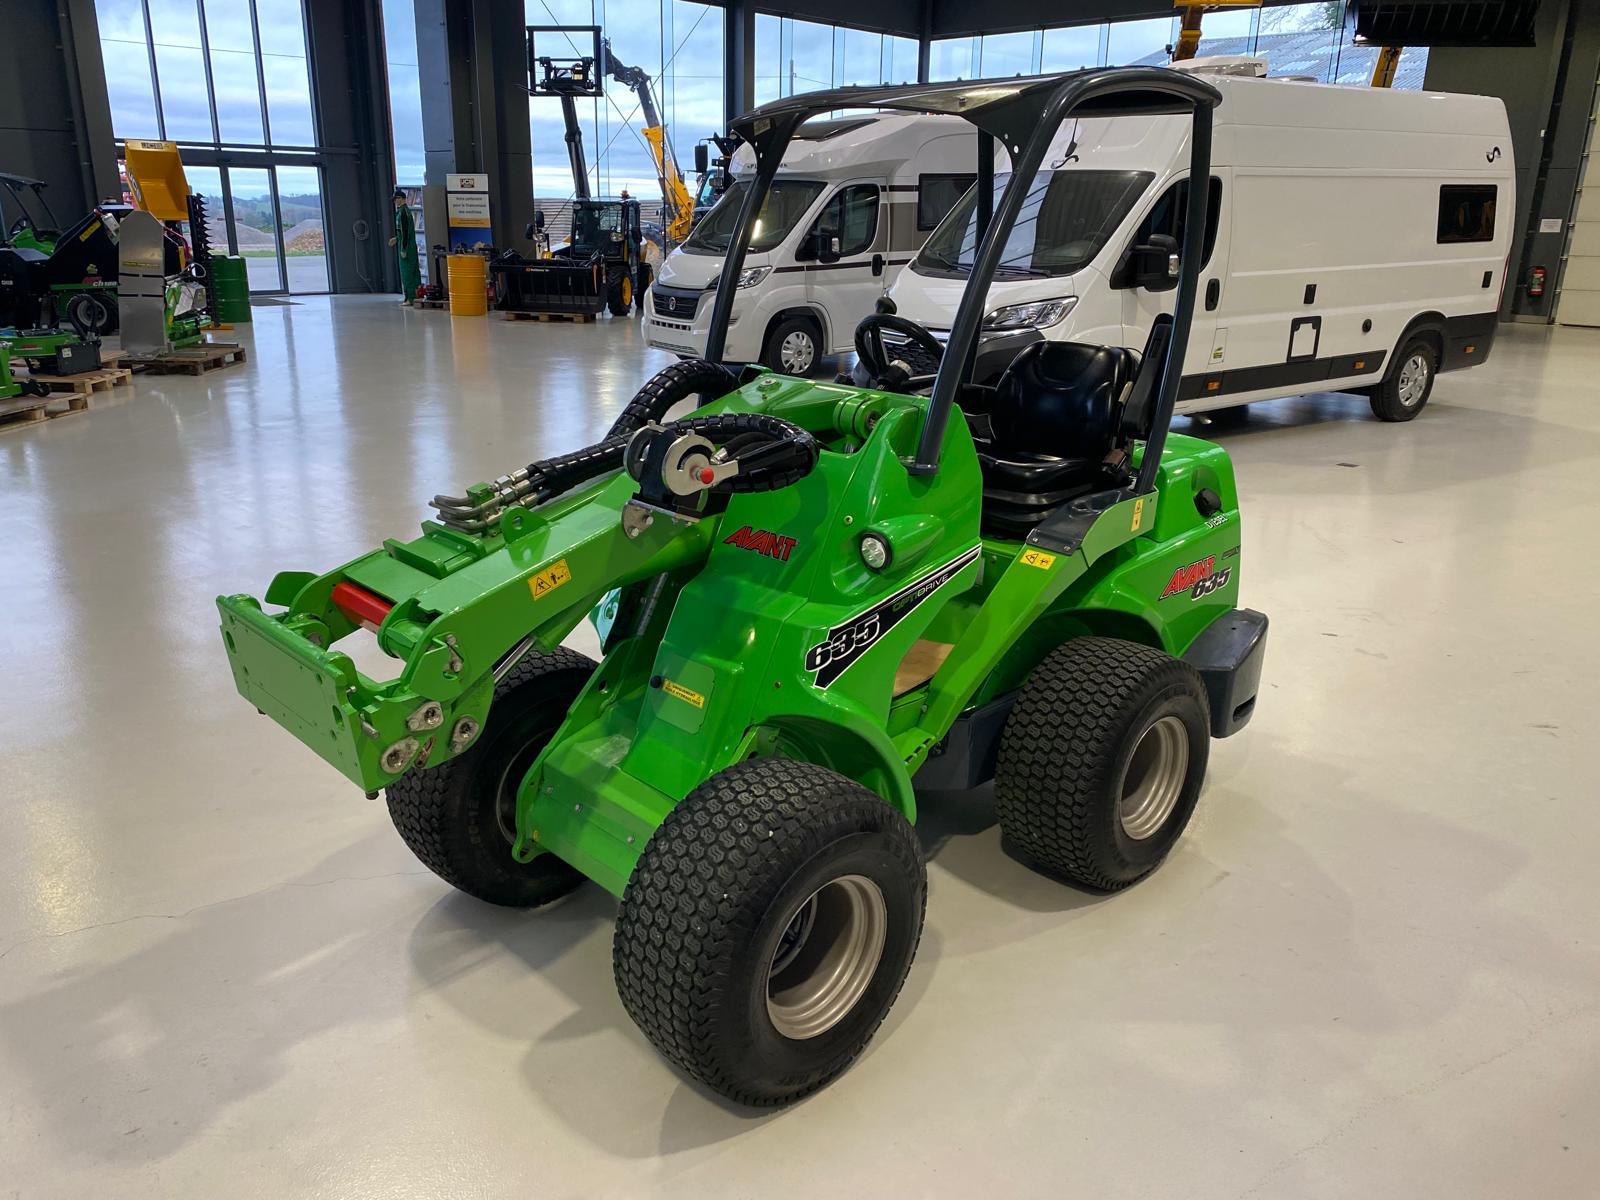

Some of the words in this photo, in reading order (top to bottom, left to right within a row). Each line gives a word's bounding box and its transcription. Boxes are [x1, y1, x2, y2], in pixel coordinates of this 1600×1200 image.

[1204, 514, 1228, 529] DIESEL
[722, 525, 798, 562] AVANT
[1158, 553, 1217, 601] AVANT
[1190, 566, 1233, 602] 635
[805, 613, 880, 672] 635
